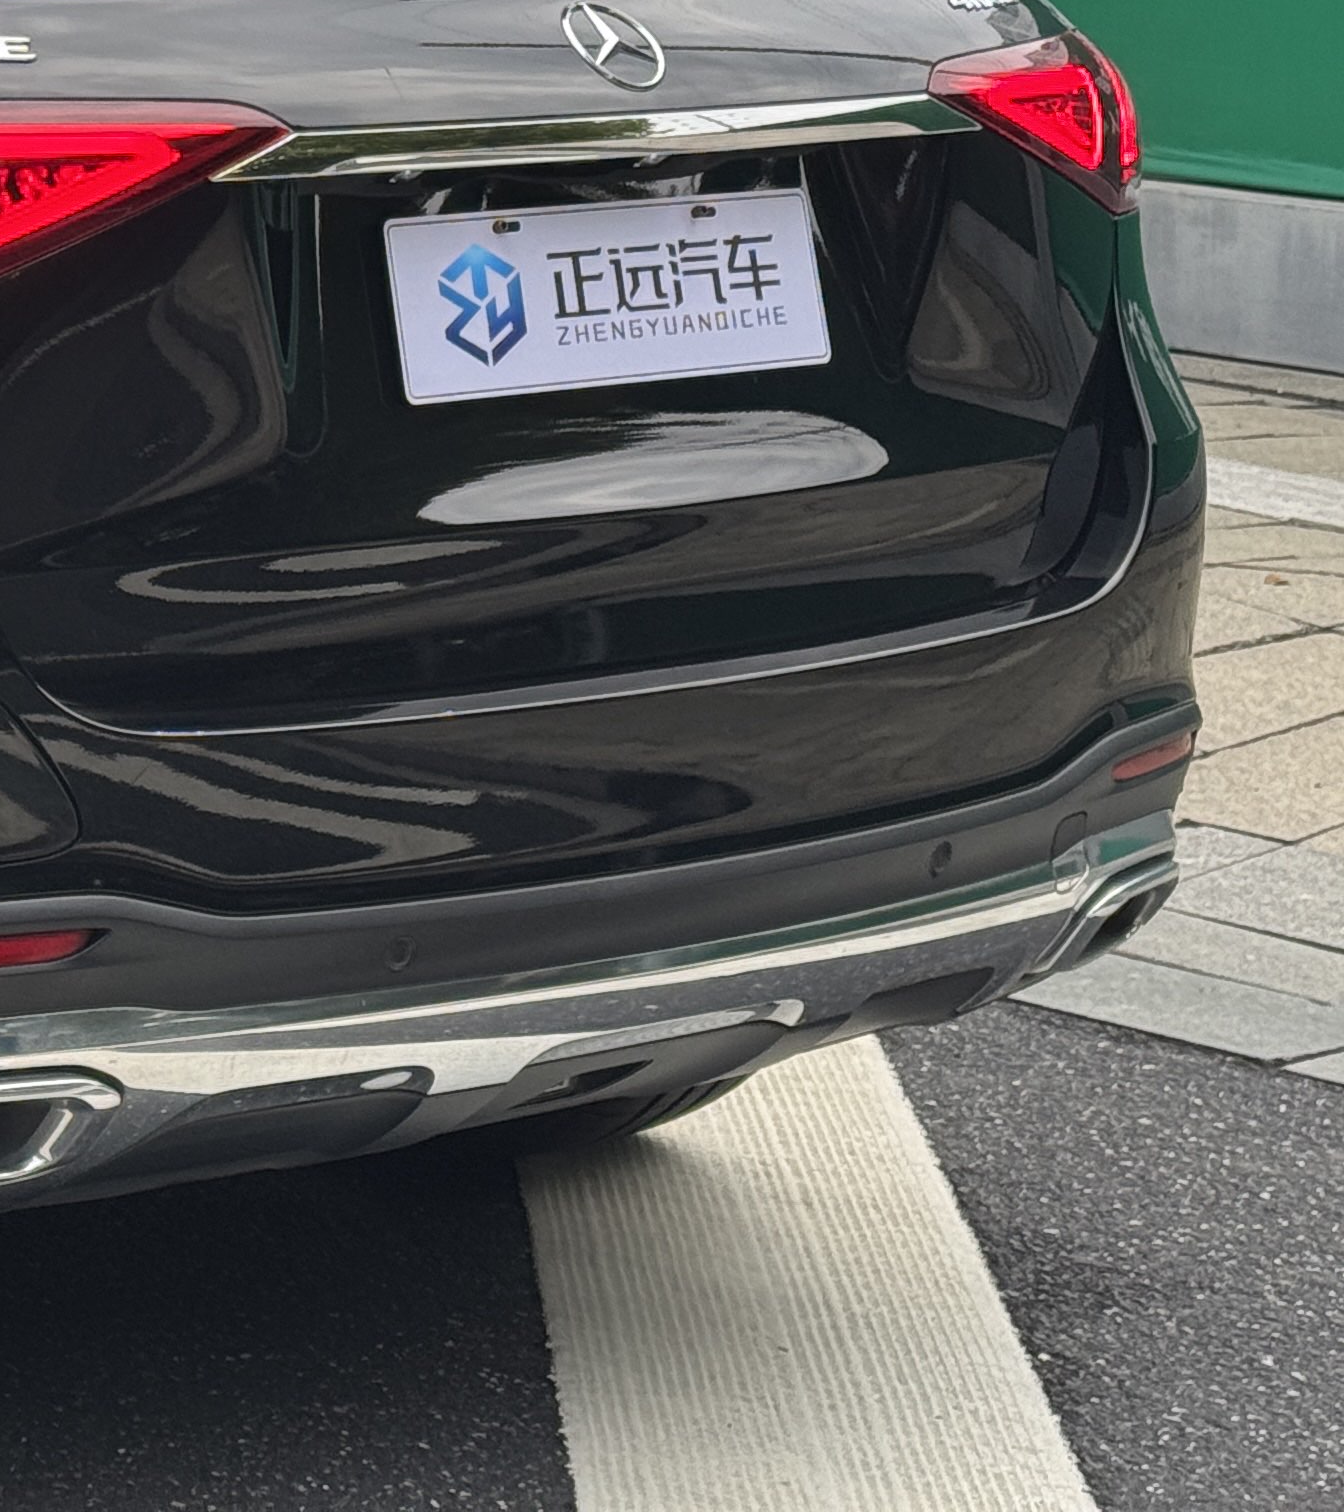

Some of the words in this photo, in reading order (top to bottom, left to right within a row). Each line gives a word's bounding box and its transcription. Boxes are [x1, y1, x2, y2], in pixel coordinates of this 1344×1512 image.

[546, 234, 782, 319] 正远汽车
[555, 305, 788, 346] ZHENGYUANQICHE
